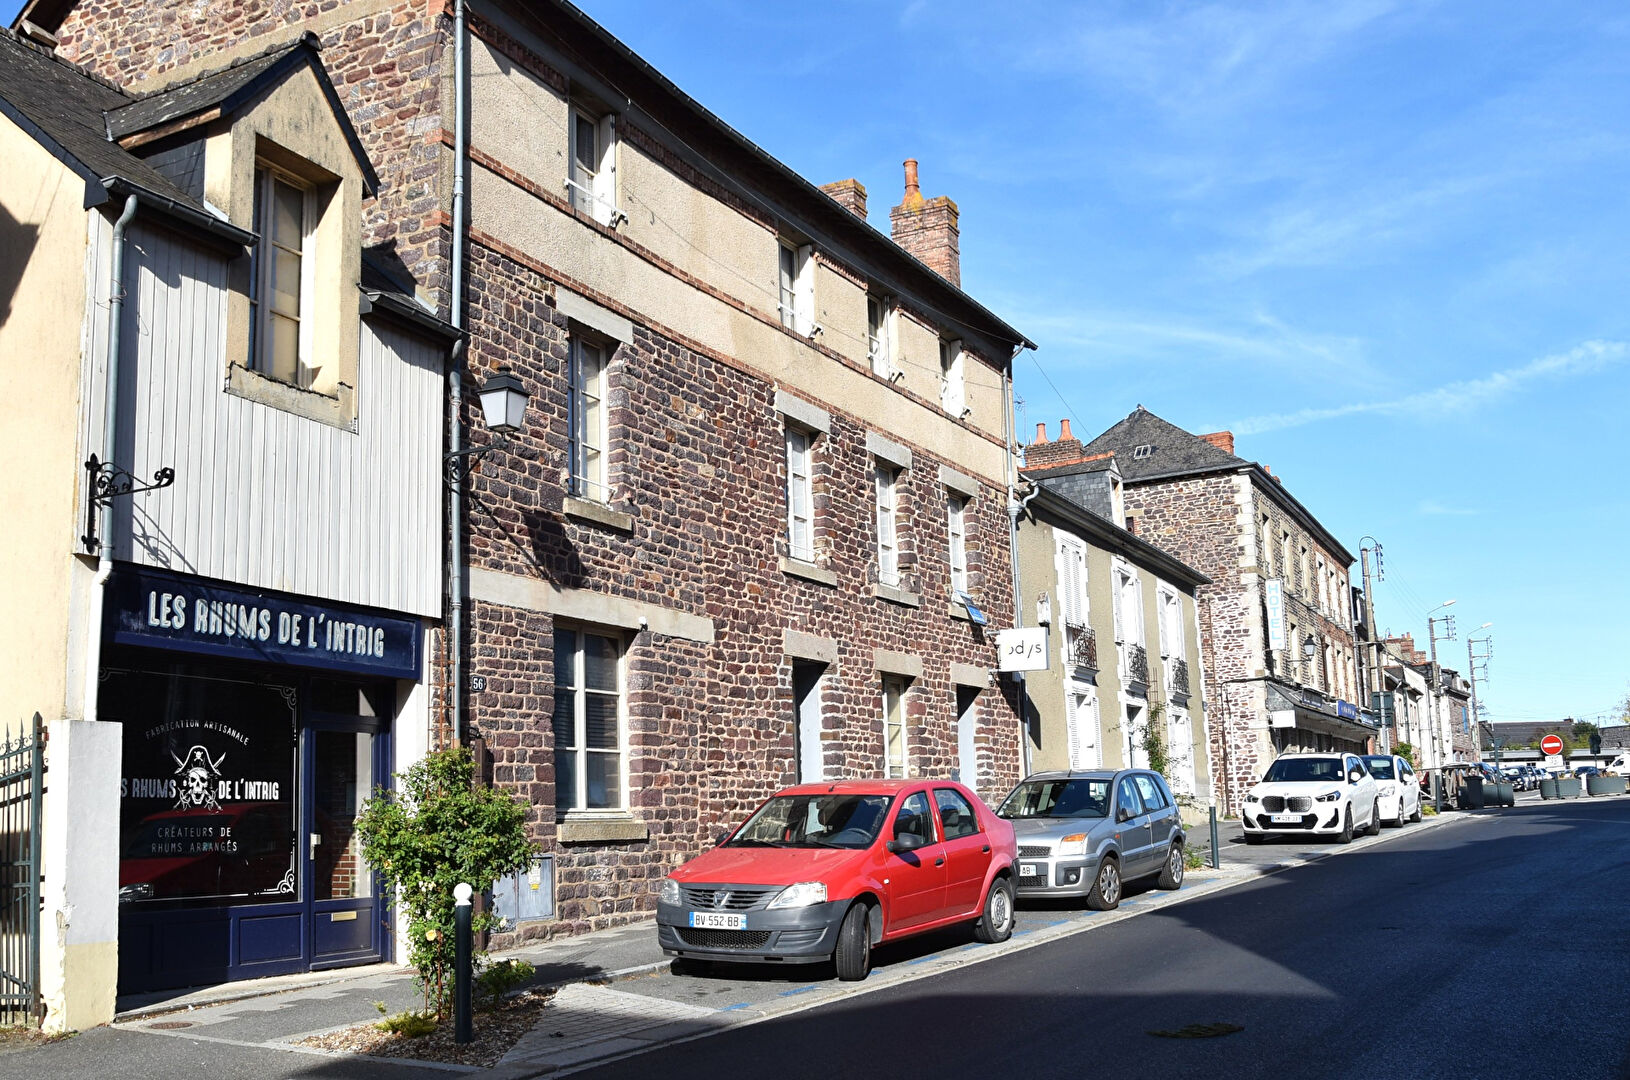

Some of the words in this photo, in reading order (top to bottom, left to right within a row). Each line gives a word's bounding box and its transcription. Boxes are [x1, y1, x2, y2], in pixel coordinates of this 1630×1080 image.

[1268, 584, 1282, 640] HOTEL
[149, 590, 186, 629] LES
[194, 598, 271, 642] RHUMS
[278, 611, 301, 647] DE
[309, 612, 385, 659] L'INTRIG
[473, 678, 484, 690] 56
[146, 719, 200, 740] FABRICATION
[204, 720, 250, 746] ARTISANALE
[132, 778, 177, 799] RHUMS
[218, 780, 231, 800] DE
[235, 777, 279, 800] L'INTRIG
[157, 825, 214, 838] CRÉATEURS
[220, 827, 232, 837] DE
[151, 842, 183, 853] RHUMS
